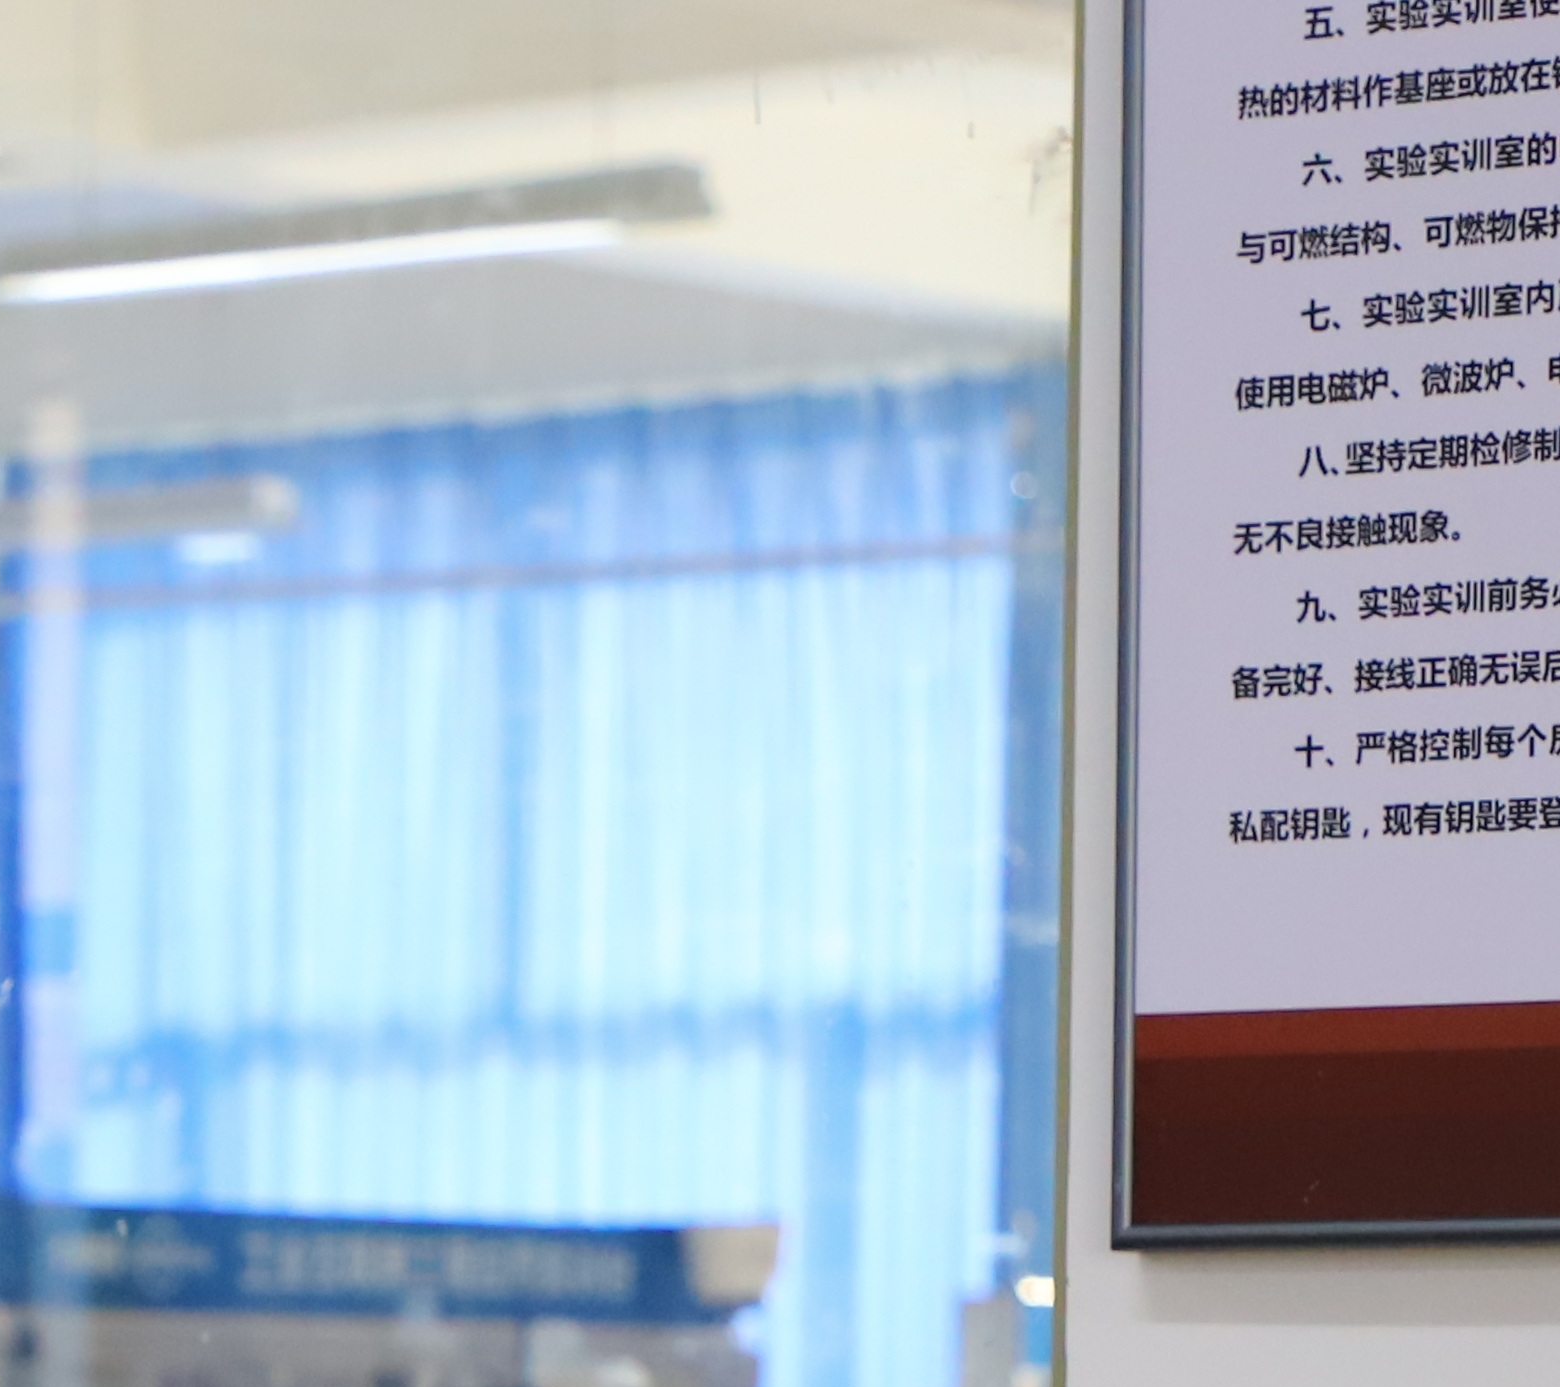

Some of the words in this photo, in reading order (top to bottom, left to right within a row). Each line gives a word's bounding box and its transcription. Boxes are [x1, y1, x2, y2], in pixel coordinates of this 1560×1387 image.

[1233, 509, 1461, 555] 无不良接触现象。
